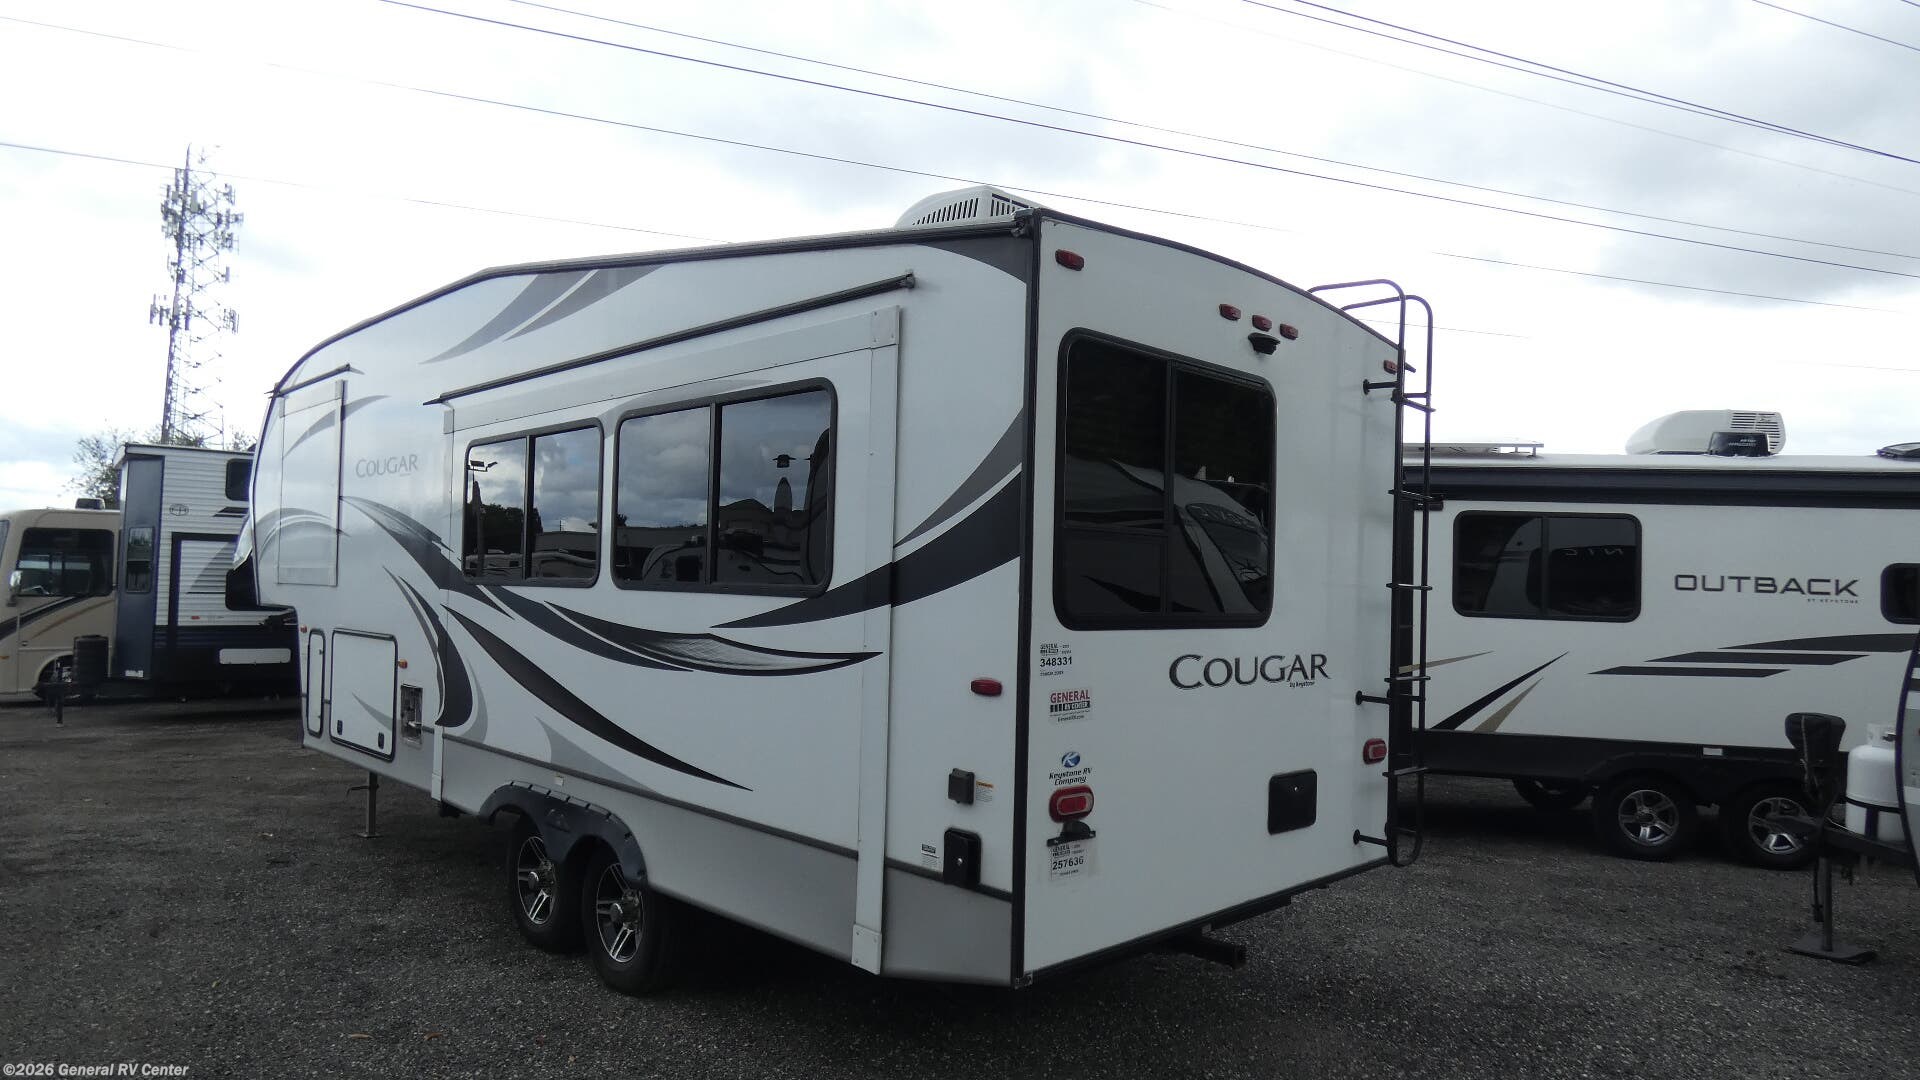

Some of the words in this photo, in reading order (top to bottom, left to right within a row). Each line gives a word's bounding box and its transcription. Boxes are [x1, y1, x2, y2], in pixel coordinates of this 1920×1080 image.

[355, 453, 419, 478] COUGAR
[1674, 574, 1860, 598] OUTBACK
[1040, 656, 1073, 668] 348331
[1169, 653, 1332, 690] COUGAR
[1050, 689, 1090, 704] GENERAL
[1049, 769, 1082, 780] Keystone
[1083, 767, 1093, 775] RV
[1054, 776, 1087, 786] Company
[1052, 856, 1084, 871] 257636
